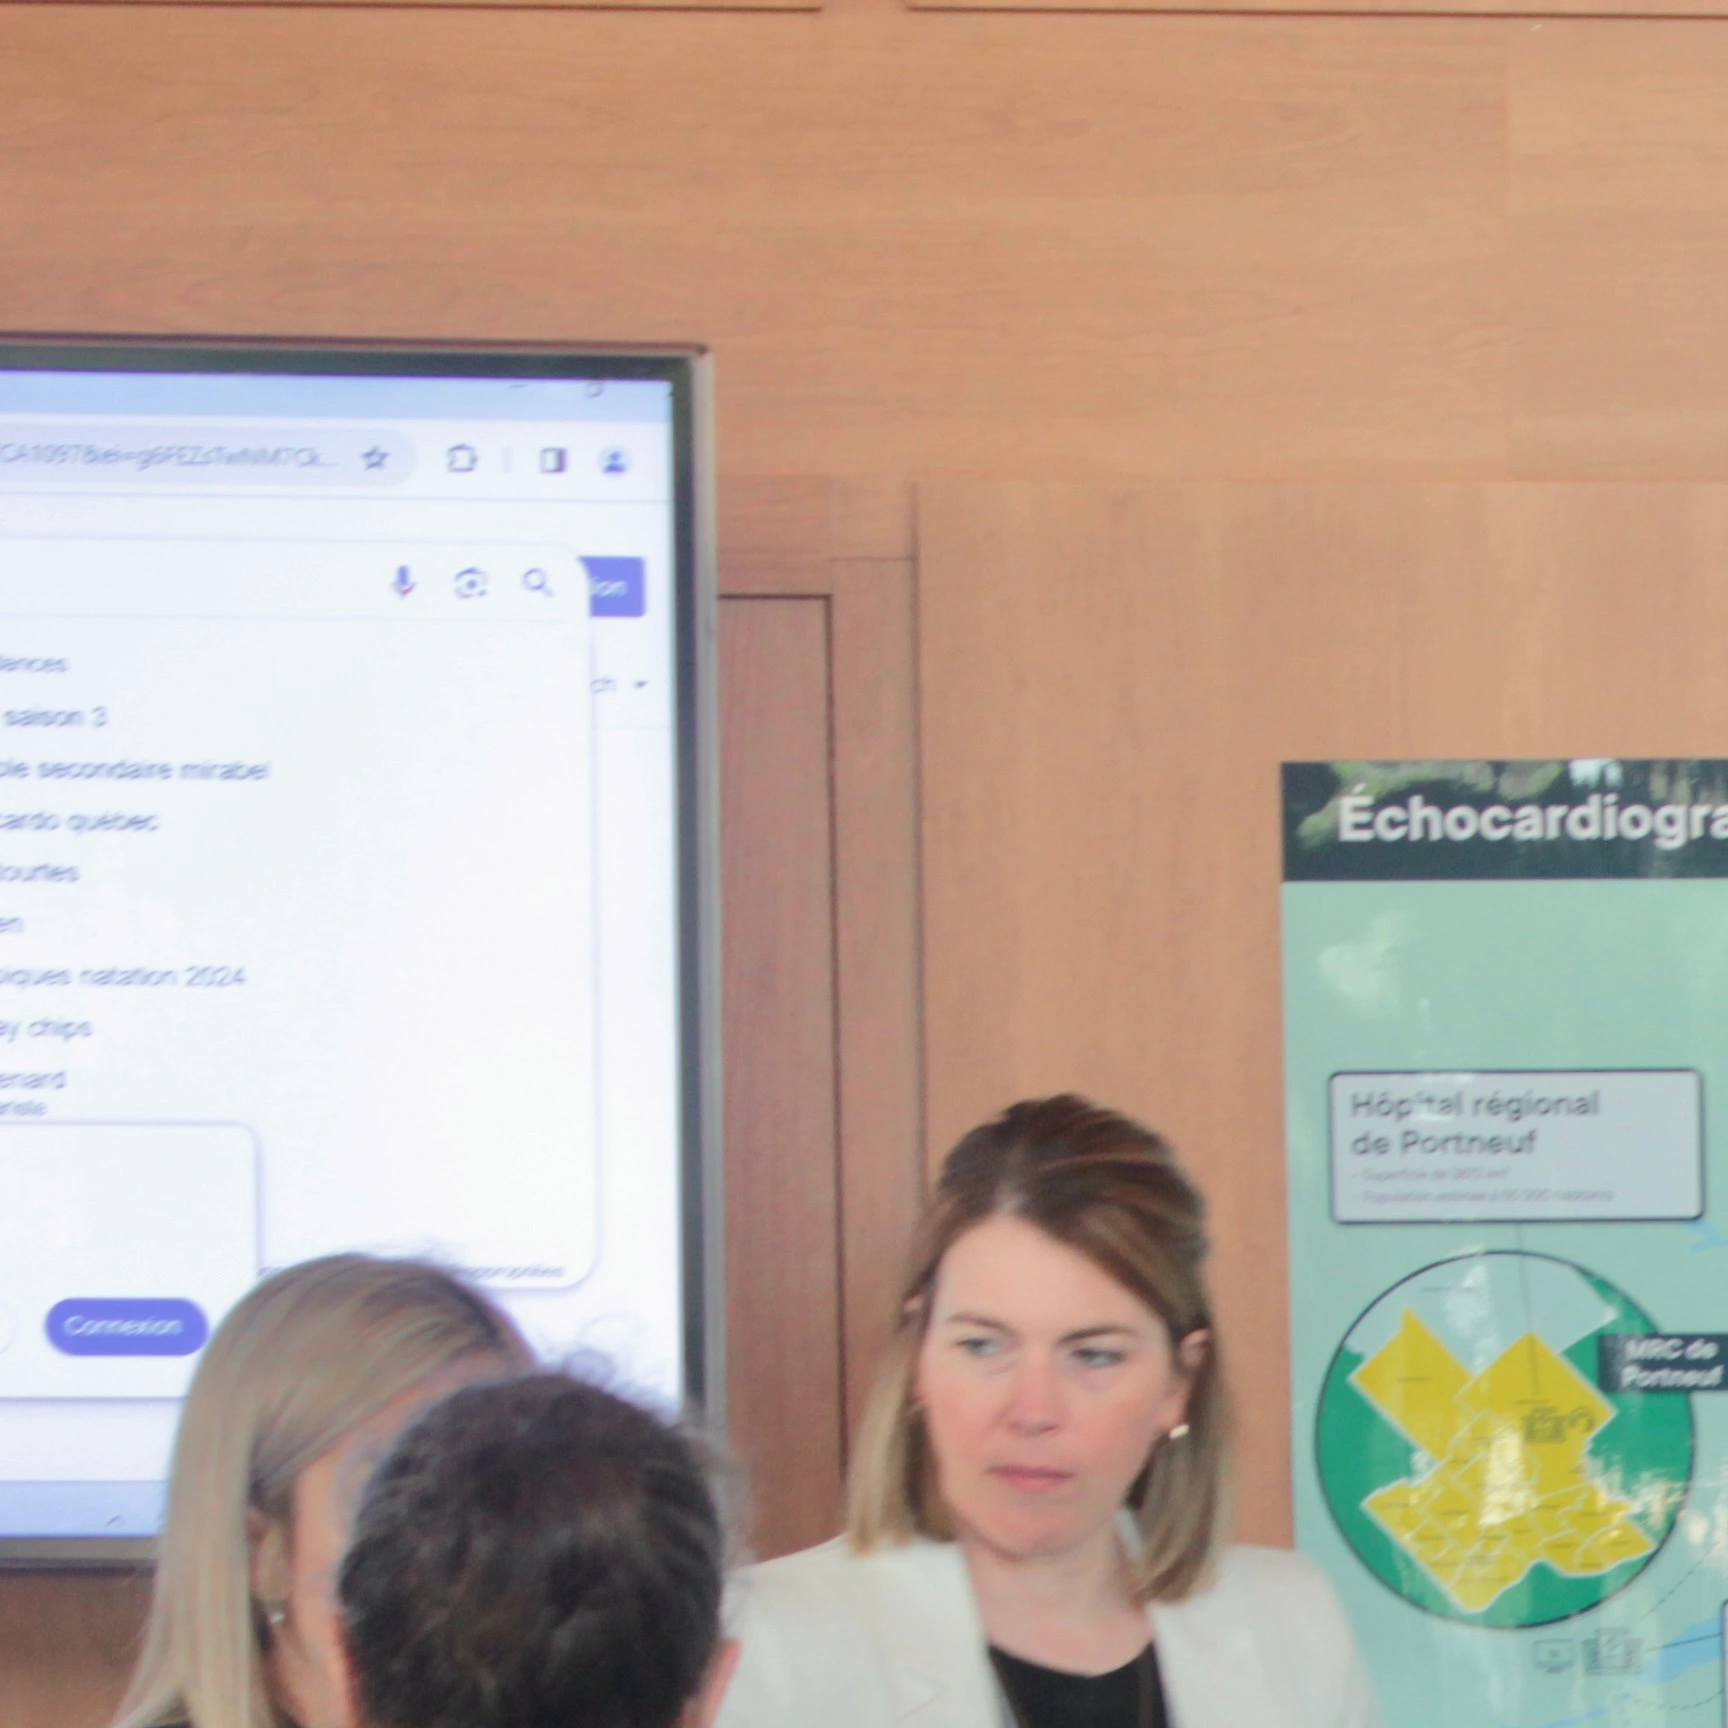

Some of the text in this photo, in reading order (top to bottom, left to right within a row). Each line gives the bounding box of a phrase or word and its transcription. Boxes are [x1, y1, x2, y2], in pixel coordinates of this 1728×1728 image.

[3, 705, 108, 728] saison 3
[38, 758, 173, 780] secondaire
[179, 758, 270, 781] mirabel
[66, 809, 159, 834] québec
[80, 966, 178, 987] natation
[184, 965, 247, 988] 2024
[27, 1018, 94, 1043] chips
[1351, 1090, 1599, 1123] Hôpital régional
[1351, 1129, 1538, 1156] de Portneuf
[63, 1315, 182, 1337] Connexion
[1625, 1338, 1719, 1360] MRC de
